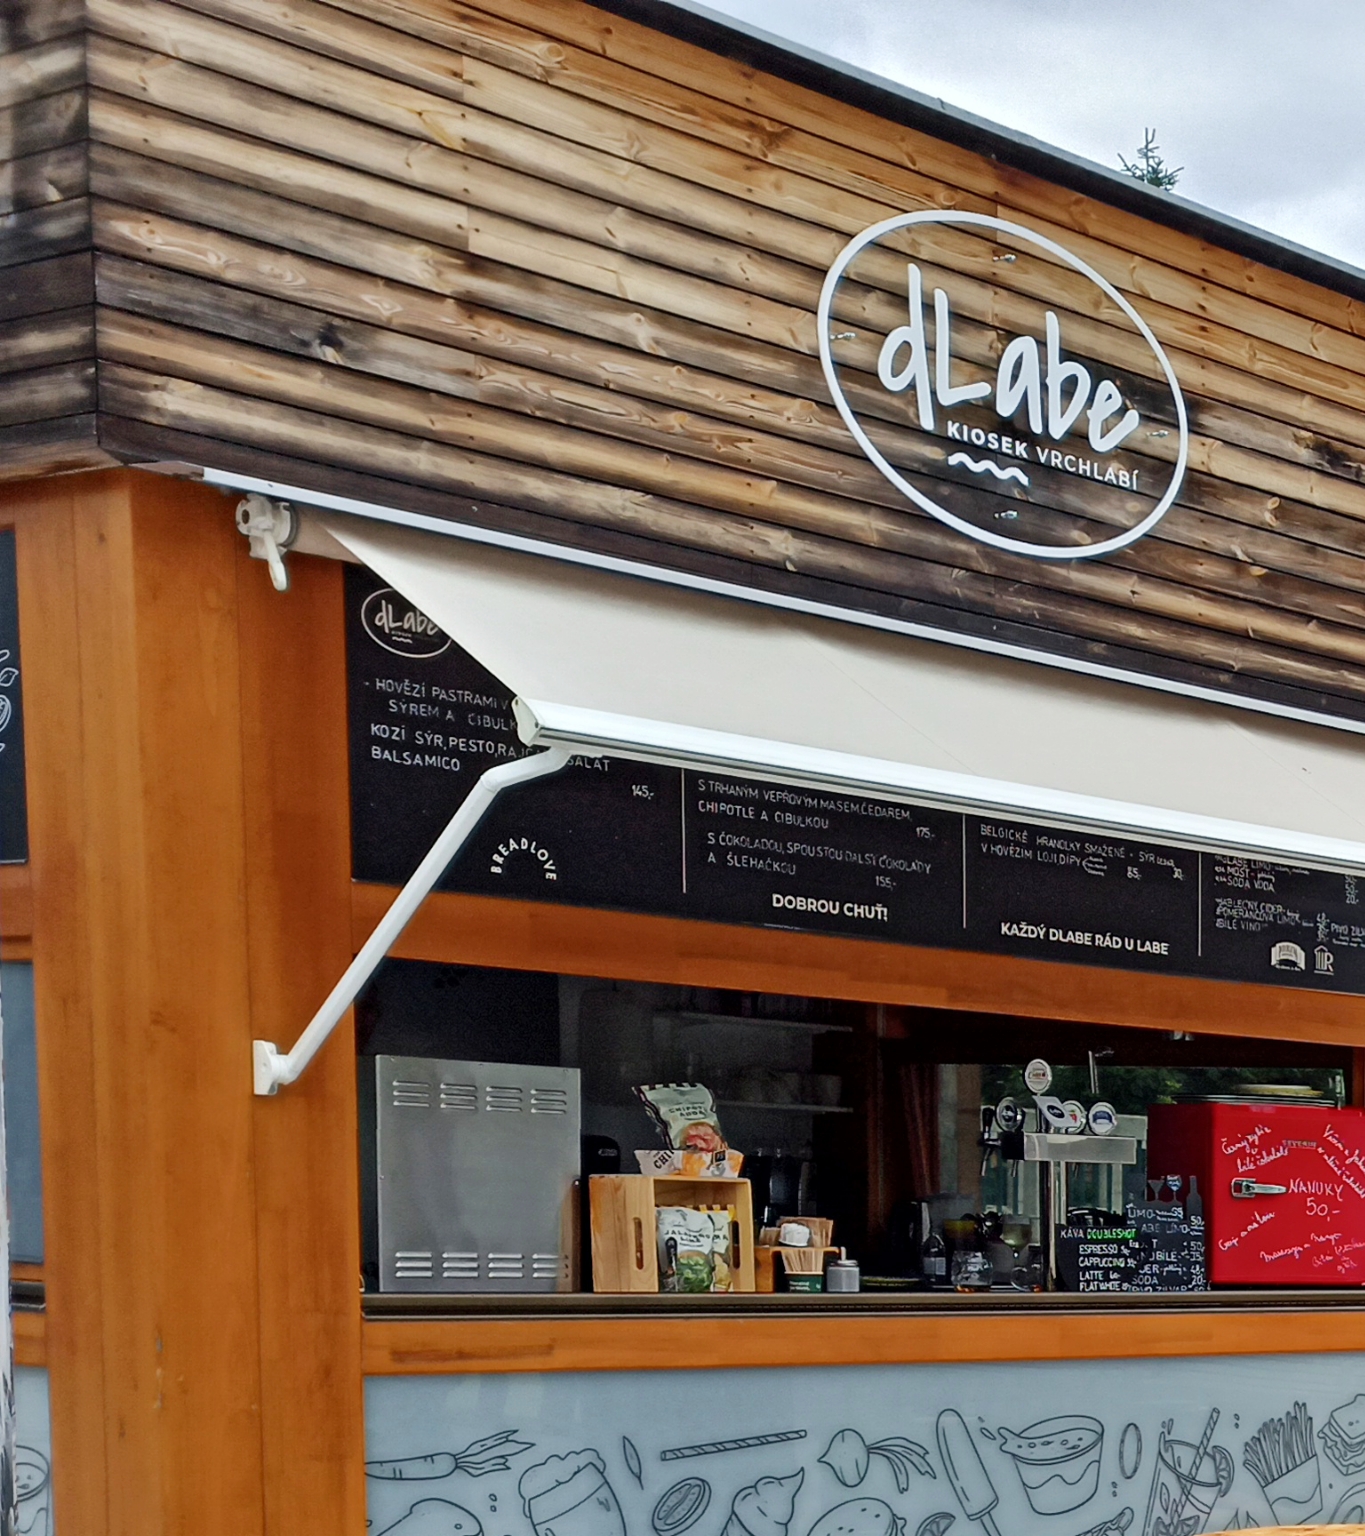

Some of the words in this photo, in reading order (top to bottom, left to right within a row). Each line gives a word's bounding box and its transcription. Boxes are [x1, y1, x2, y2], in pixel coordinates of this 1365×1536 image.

[877, 262, 1141, 453] dLabe
[946, 420, 1029, 460] KIOSEK
[1035, 444, 1140, 492] VRCHLABÍ
[431, 686, 499, 709] PASTRAMI
[445, 709, 456, 722] A
[370, 722, 406, 741] KOZÍ
[370, 746, 461, 773] BALSAMICO
[697, 779, 707, 793] S
[697, 800, 755, 820] CHIPOTLE
[759, 810, 769, 822] A
[706, 832, 716, 846] S
[980, 843, 988, 854] V
[490, 837, 558, 881] BREADLOVE
[706, 852, 717, 864] A
[771, 893, 840, 916] DOBROU
[842, 902, 889, 923] CHUŤ!
[1000, 920, 1046, 941] KAŽDÝ
[1048, 927, 1093, 947] DLABE
[1094, 932, 1123, 950] RÁD
[1124, 939, 1135, 951] U
[1136, 939, 1170, 956] LABE
[1078, 1244, 1118, 1255] ESPRESSO
[1079, 1270, 1105, 1281] LATTE
